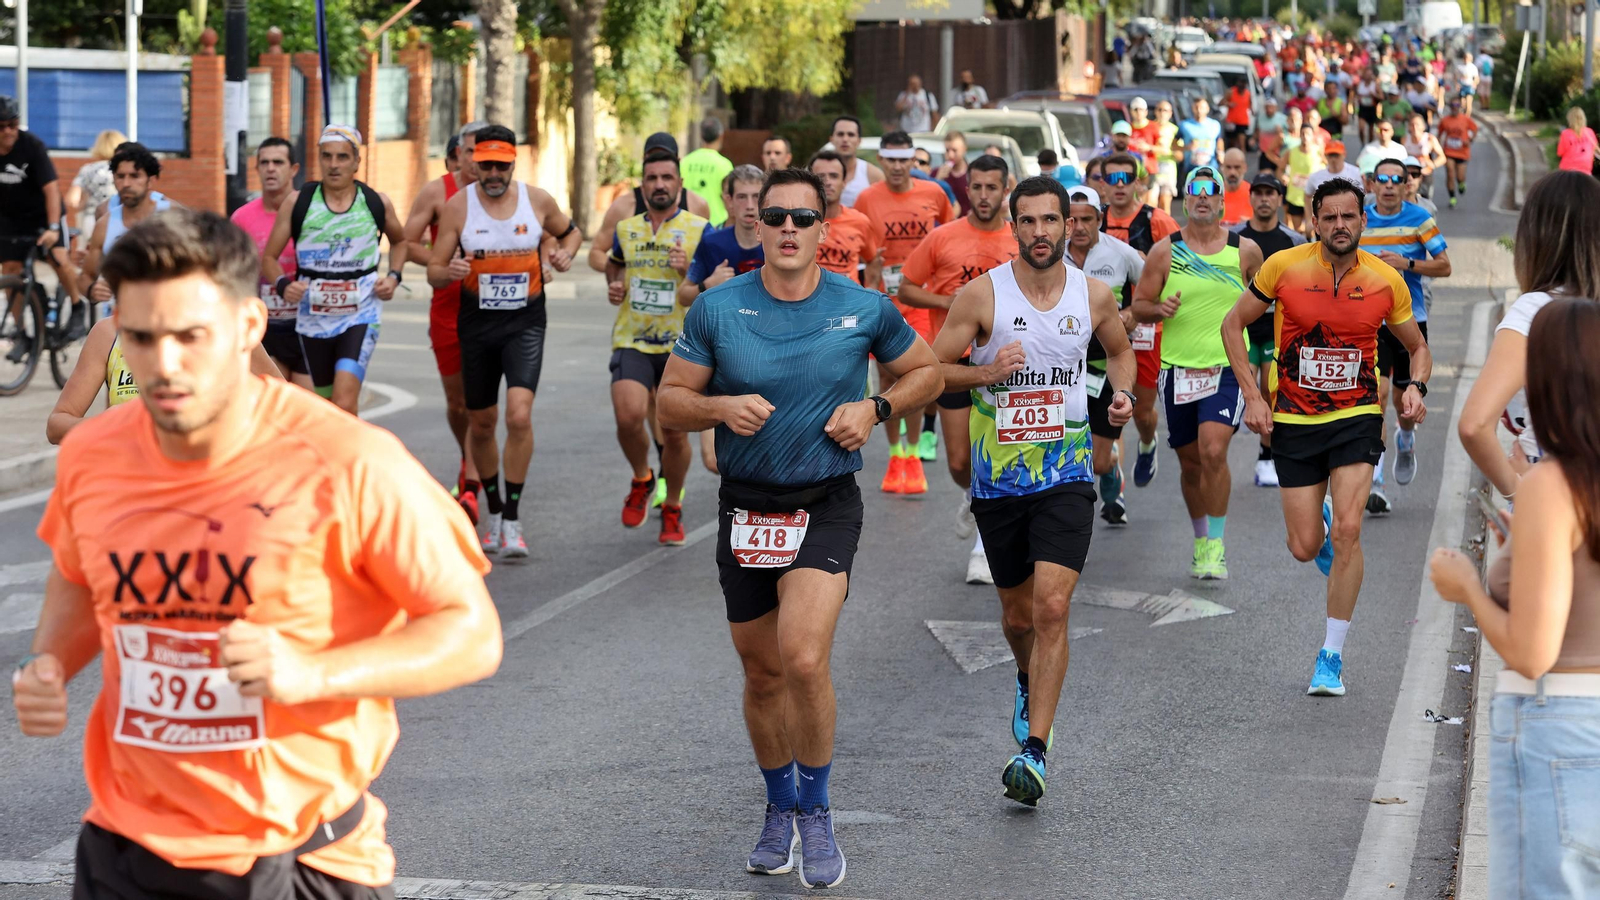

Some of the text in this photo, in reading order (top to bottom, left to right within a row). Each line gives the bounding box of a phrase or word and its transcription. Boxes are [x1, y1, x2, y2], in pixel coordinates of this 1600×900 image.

[322, 294, 347, 304] 259
[492, 286, 516, 297] 769
[644, 290, 658, 302] 73
[1316, 362, 1346, 377] 152
[1012, 407, 1049, 426] 403
[748, 528, 787, 548] 418
[109, 552, 256, 605] XXIX
[150, 672, 218, 710] 396
